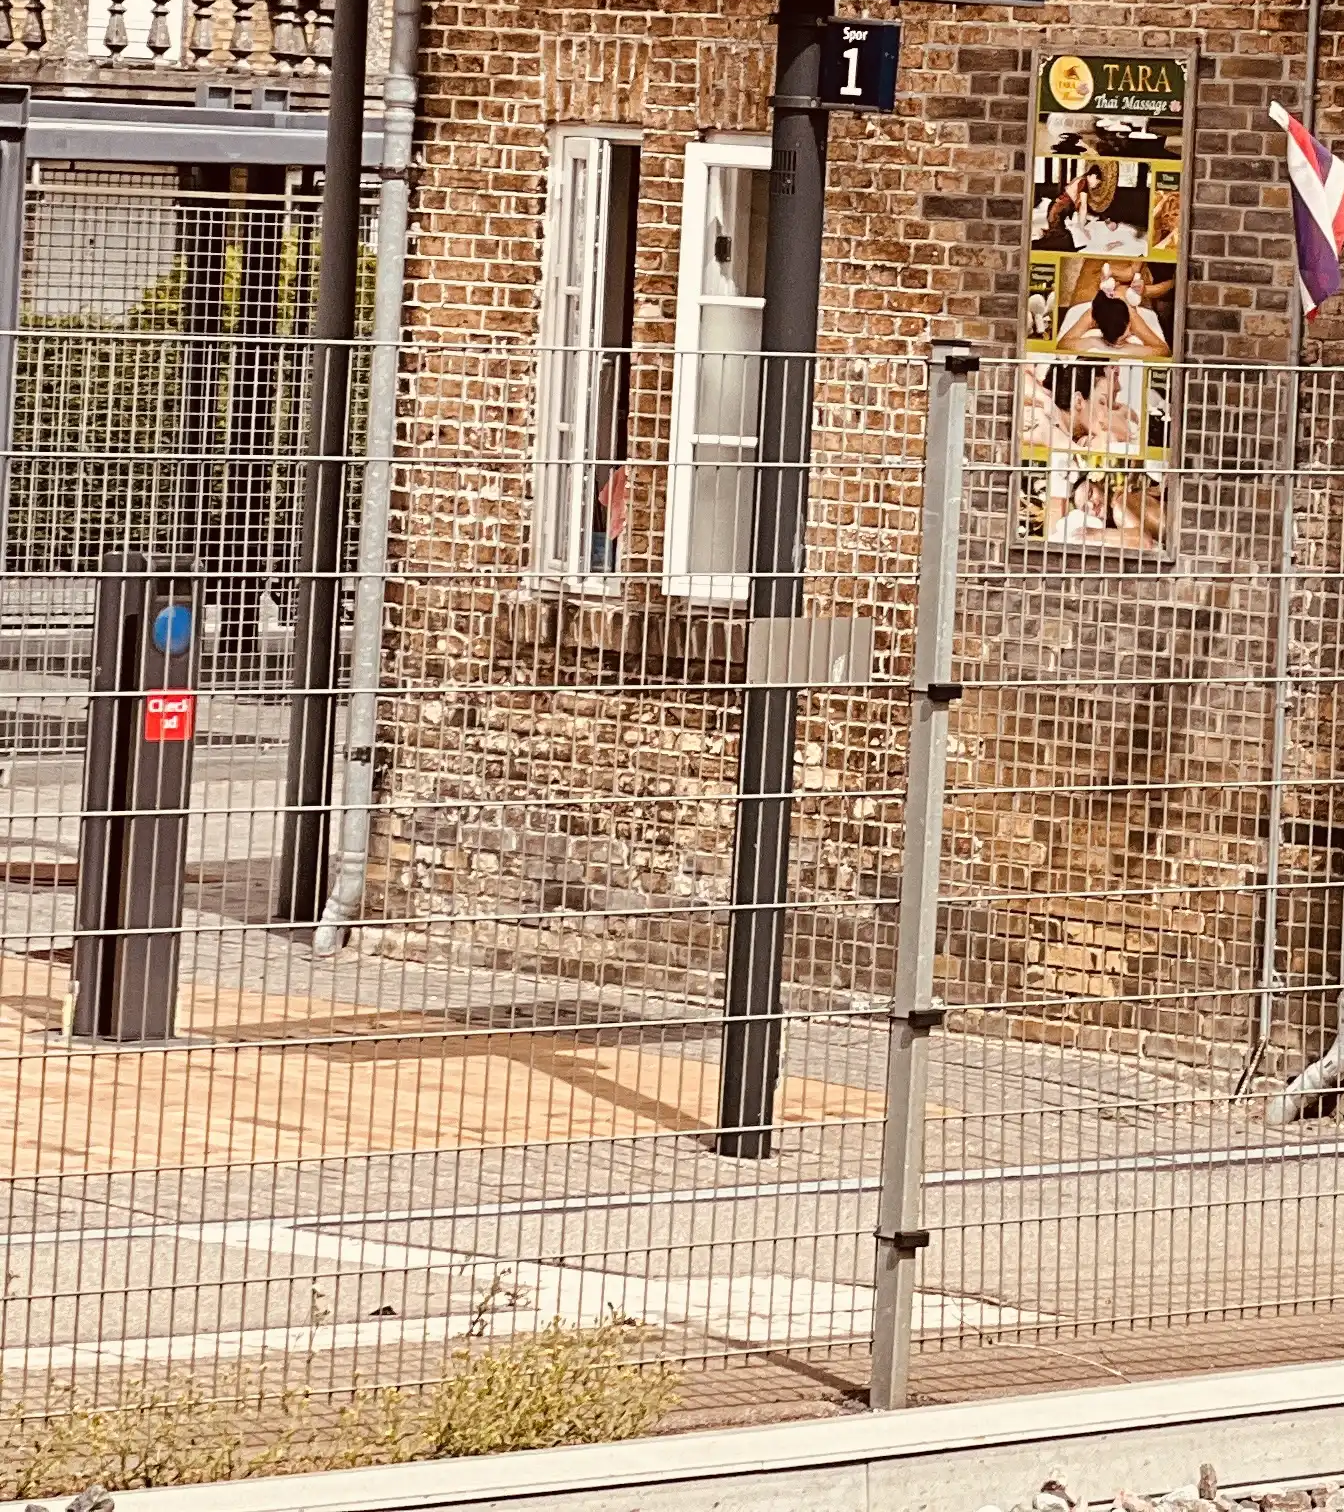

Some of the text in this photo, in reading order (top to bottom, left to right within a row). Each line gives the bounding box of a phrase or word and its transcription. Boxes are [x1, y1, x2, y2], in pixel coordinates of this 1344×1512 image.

[842, 26, 869, 44] Spor
[840, 47, 862, 97] 1
[1103, 63, 1173, 93] TARA
[1094, 92, 1119, 109] Thai
[1121, 96, 1168, 116] Massage
